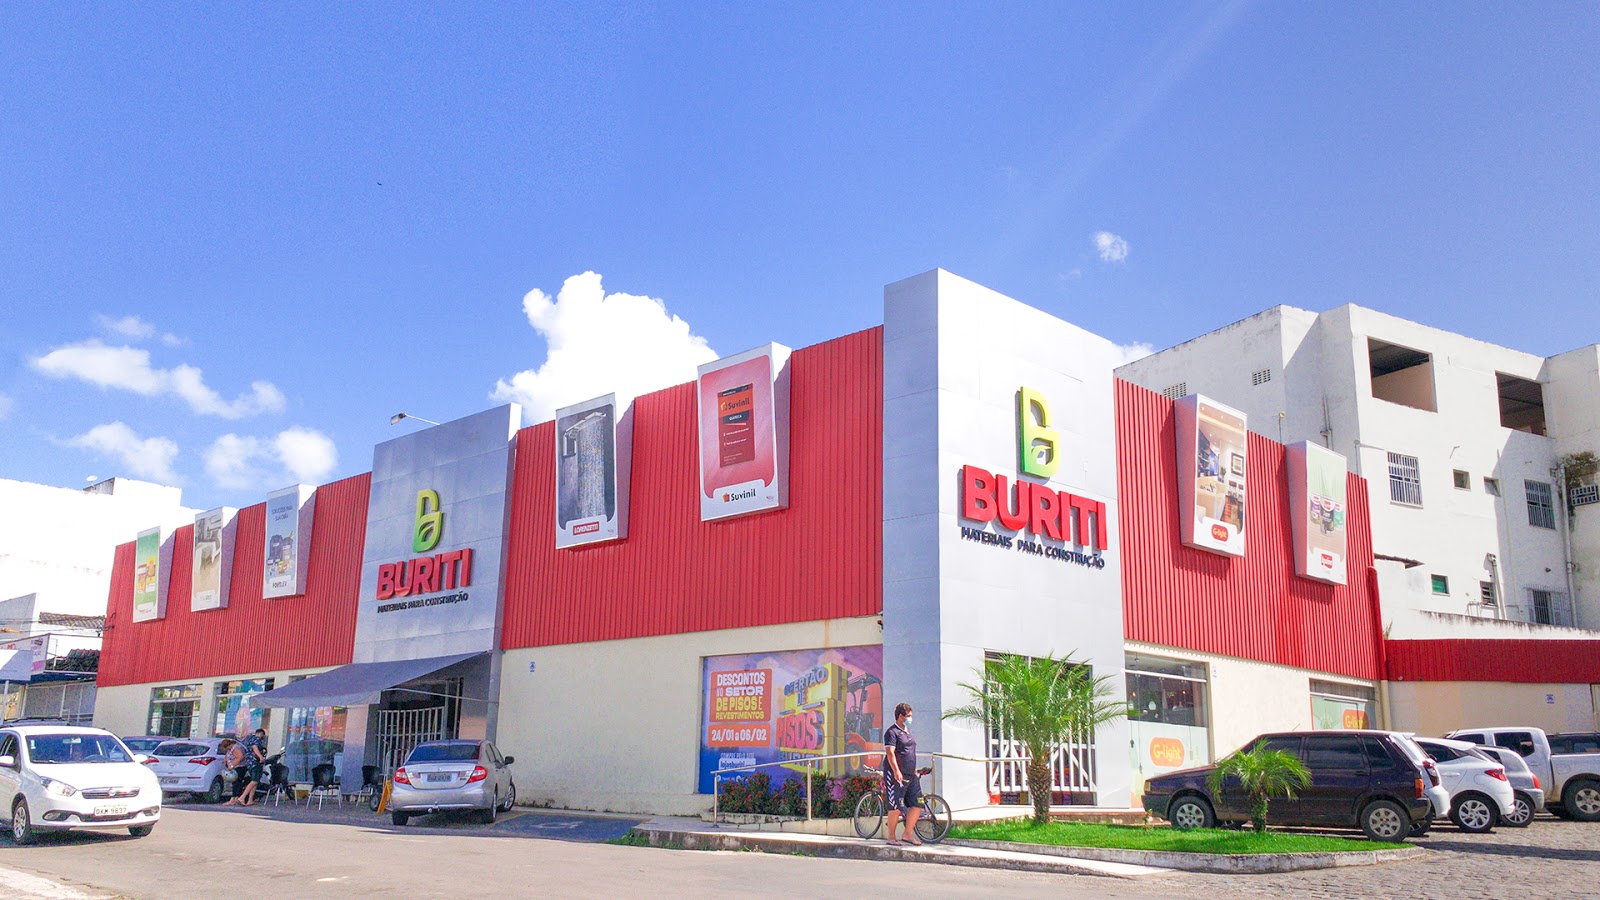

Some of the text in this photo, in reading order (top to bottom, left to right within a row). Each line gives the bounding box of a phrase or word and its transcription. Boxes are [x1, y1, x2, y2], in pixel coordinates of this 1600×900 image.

[728, 398, 750, 410] Suvinil
[731, 488, 756, 502] Suvinil
[962, 464, 1108, 551] BURITI
[961, 526, 1105, 570] MATERIAIS PARA CONSTRUÇÃO
[376, 548, 472, 600] BURITI
[377, 590, 469, 614] MATERIAIS PARA CONSTRUÇÃO
[717, 671, 766, 686] DESCONTOS
[784, 666, 827, 696] OFERTÃO
[716, 685, 764, 697] NO SETOR
[797, 690, 806, 707] DE
[716, 695, 763, 712] DE PISOS E
[715, 710, 764, 720] REVESTIMENTOS
[711, 727, 767, 742] 24/01 a 06/02
[775, 709, 822, 751] PISOS
[1153, 744, 1182, 761] G-light
